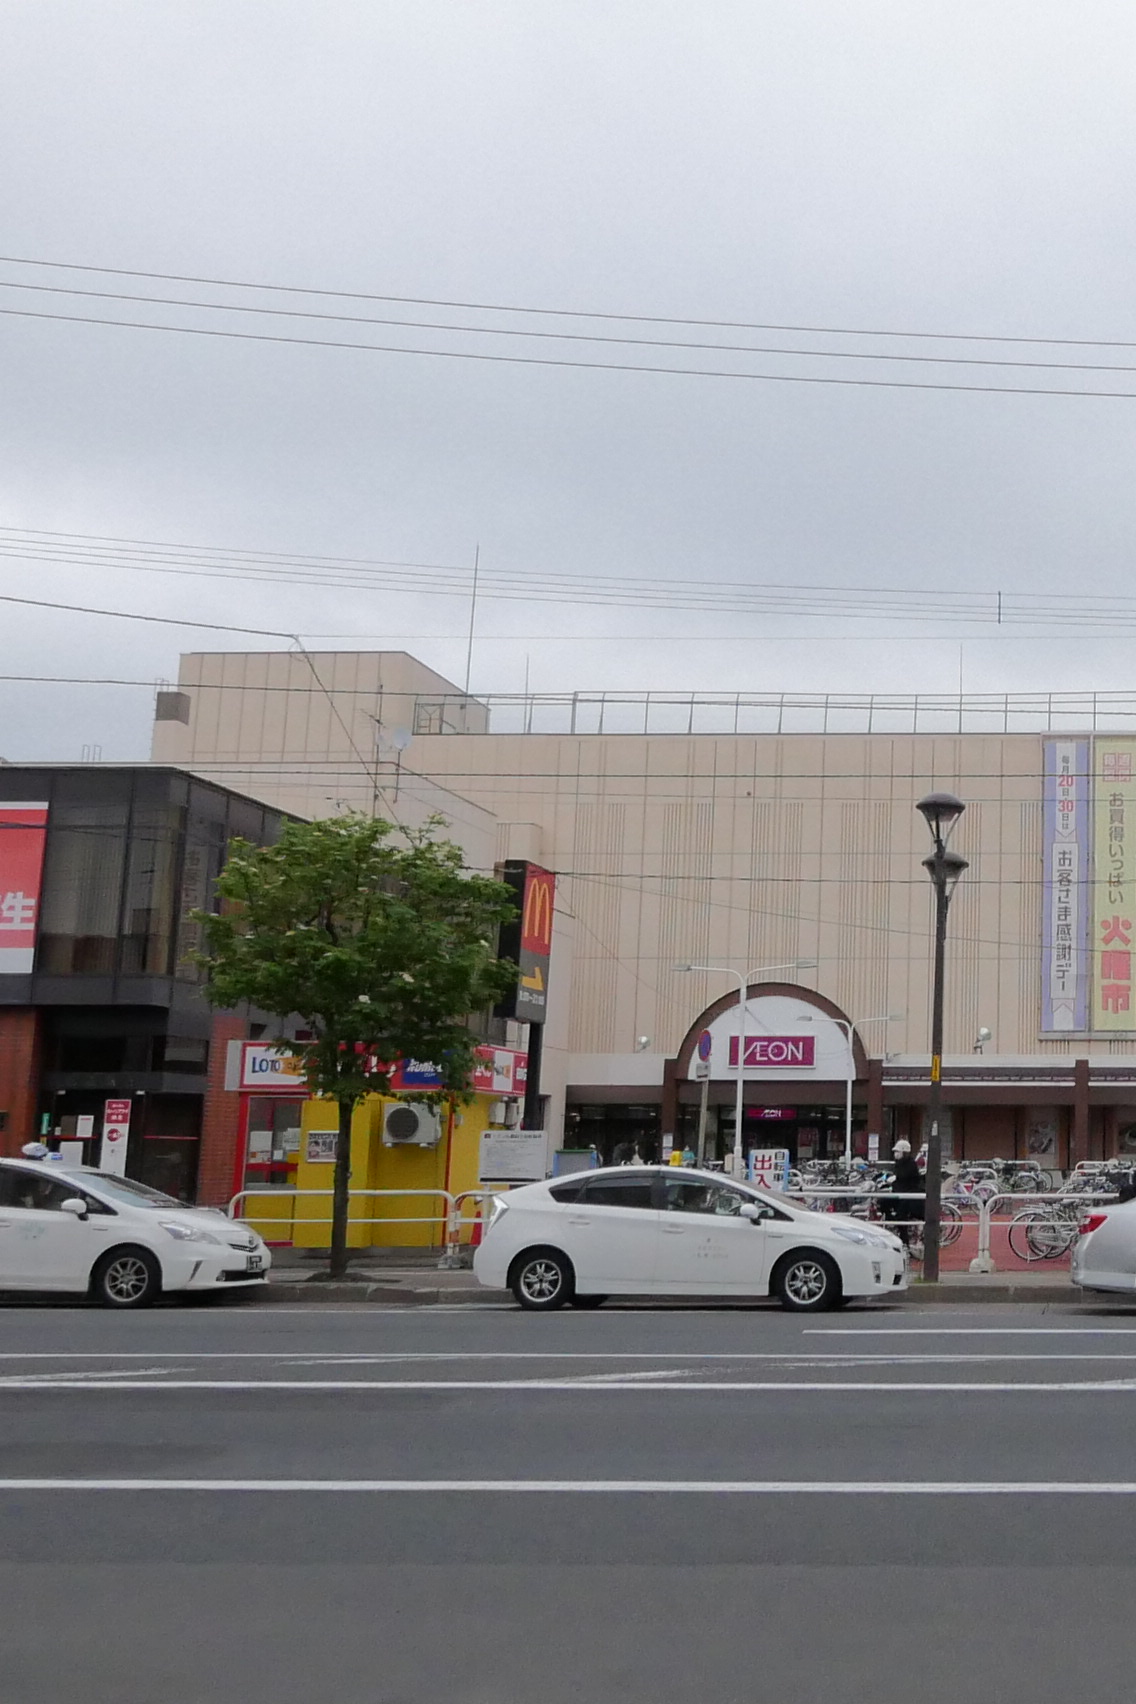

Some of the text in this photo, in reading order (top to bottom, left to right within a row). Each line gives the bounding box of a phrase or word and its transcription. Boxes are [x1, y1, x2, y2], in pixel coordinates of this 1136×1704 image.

[1108, 792, 1124, 905] お買得いっぱい
[1056, 850, 1073, 991] お客さま感謝デー
[753, 1154, 772, 1189] 出入
